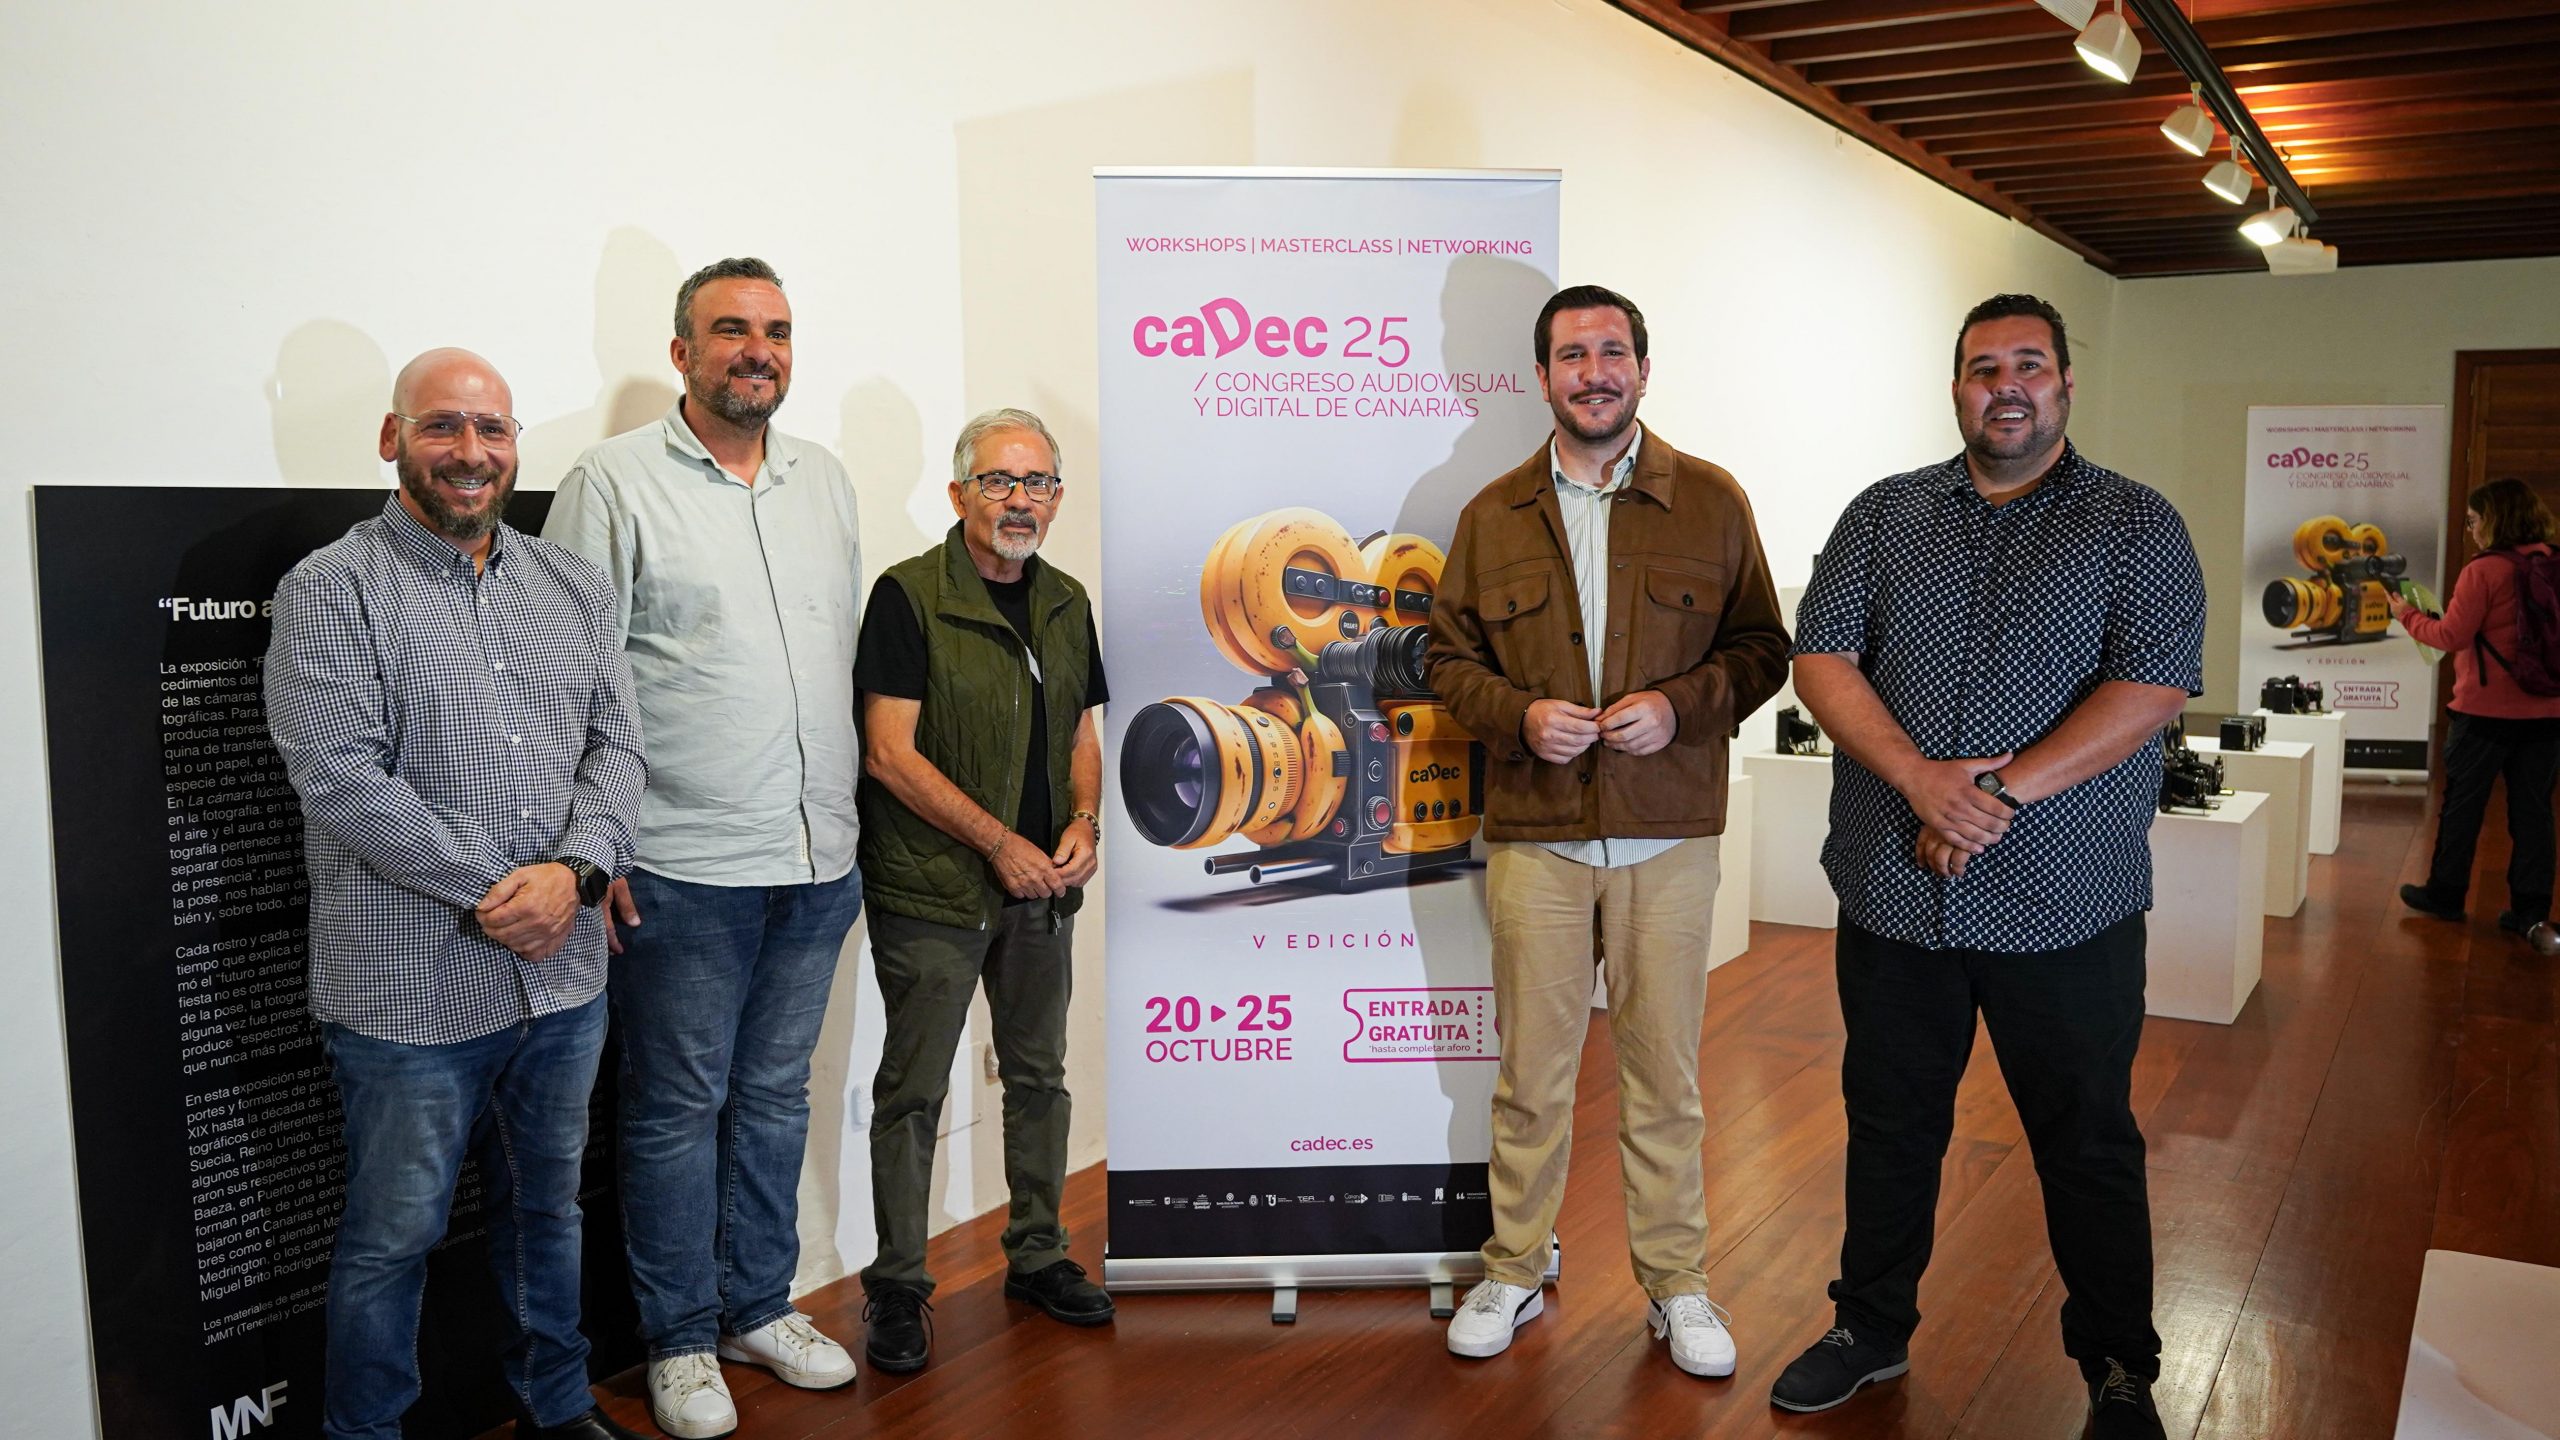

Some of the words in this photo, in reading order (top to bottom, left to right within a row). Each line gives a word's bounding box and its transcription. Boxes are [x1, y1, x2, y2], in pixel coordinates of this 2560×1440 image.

[1127, 237, 1246, 253] WORKSHOPS
[1261, 238, 1393, 254] MASTERCLASS
[1407, 239, 1533, 255] NETWORKING
[1133, 298, 1328, 359] caDec
[1343, 316, 1411, 368] 25
[1215, 372, 1355, 393] CONGRESO
[1361, 372, 1526, 394] AUDIOVISUAL
[1194, 397, 1209, 416] Y
[1216, 396, 1310, 418] DIGITAL
[1316, 397, 1349, 417] DE
[1354, 397, 1480, 418] CANARIAS
[2267, 447, 2339, 468] caDec
[2343, 453, 2369, 471] 25
[2296, 472, 2348, 480] CONGRESO
[2350, 472, 2410, 480] AUDIOVISUAL
[2296, 480, 2330, 488] DIGITAL
[2332, 480, 2344, 488] DE
[2347, 480, 2394, 488] CANARIAS
[160, 662, 177, 674] La
[180, 658, 247, 674] exposición
[161, 676, 237, 691] cedimientos
[240, 673, 258, 685] del
[162, 696, 179, 708] de
[182, 695, 201, 706] las
[204, 692, 257, 705] cámaras
[2343, 694, 2381, 702] GRATUITA
[231, 707, 259, 719] Para
[164, 726, 220, 744] producía
[164, 745, 200, 761] quina
[203, 743, 220, 755] de
[165, 763, 181, 776] tal
[196, 762, 212, 772] un
[1410, 763, 1460, 783] caDec
[166, 776, 216, 793] especie
[220, 774, 236, 786] de
[239, 771, 265, 784] vida
[167, 797, 184, 809] En
[188, 795, 204, 807] La
[207, 790, 253, 804] cámara
[168, 815, 184, 826] en
[188, 812, 199, 823] la
[169, 830, 180, 843] el
[184, 828, 208, 840] aire
[238, 821, 265, 833] aura
[170, 843, 217, 860] tografía
[221, 835, 281, 855] pertenece
[171, 860, 219, 876] separar
[221, 857, 244, 868] dos
[246, 850, 292, 865] láminas
[172, 880, 189, 893] de
[173, 897, 184, 909] la
[225, 889, 248, 900] nos
[250, 882, 290, 896] hablan
[174, 912, 201, 926] bién
[219, 904, 253, 918] sobre
[175, 944, 210, 959] Cada
[213, 938, 247, 952] rostro
[260, 929, 290, 943] cada
[1253, 935, 1265, 949] V
[1286, 930, 1416, 949] EDICIÓN
[176, 959, 219, 975] tiempo
[222, 954, 246, 968] que
[248, 946, 291, 962] explica
[178, 978, 198, 992] mó
[201, 975, 212, 988] el
[178, 994, 212, 1008] fiesta
[214, 990, 230, 1001] no
[232, 987, 247, 998] es
[249, 982, 272, 994] otra
[274, 975, 303, 989] cosa
[180, 1013, 197, 1025] de
[200, 1010, 211, 1021] la
[1145, 996, 1200, 1033] 20
[1237, 994, 1292, 1031] 25
[1368, 1000, 1470, 1017] ENTRADA
[181, 1024, 223, 1042] alguna
[225, 1019, 246, 1031] vez
[249, 1015, 267, 1026] fue
[1368, 1024, 1470, 1041] GRATUITA
[182, 1039, 233, 1060] produce
[1146, 1038, 1293, 1063] OCTUBRE
[1398, 1044, 1445, 1054] completar
[1447, 1043, 1471, 1052] aforo
[183, 1061, 207, 1076] que
[210, 1052, 248, 1068] nunca
[251, 1044, 276, 1058] más
[185, 1094, 202, 1107] En
[204, 1088, 230, 1102] esta
[232, 1072, 295, 1095] exposición
[187, 1106, 225, 1126] portes
[238, 1090, 289, 1110] formatos
[187, 1123, 209, 1139] XIX
[211, 1117, 245, 1133] hasta
[248, 1113, 258, 1123] la
[261, 1101, 305, 1120] década
[189, 1132, 249, 1156] tográficos
[251, 1128, 266, 1139] de
[239, 1142, 273, 1159] Reino
[1290, 1136, 1374, 1153] cadec.es
[192, 1167, 239, 1189] algunos
[242, 1153, 289, 1174] trabajos
[291, 1148, 306, 1160] de
[193, 1188, 225, 1205] raron
[227, 1181, 248, 1195] sus
[250, 1161, 317, 1188] respectivos
[239, 1196, 254, 1207] en
[257, 1184, 295, 1202] Puerto
[195, 1217, 237, 1237] forman
[241, 1207, 271, 1226] parte
[275, 1200, 290, 1212] de
[294, 1193, 315, 1207] una
[197, 1232, 242, 1253] bajaron
[245, 1226, 260, 1238] en
[263, 1210, 314, 1232] Canarias
[198, 1253, 226, 1269] bres
[229, 1242, 262, 1260] como
[265, 1235, 275, 1248] el
[201, 1278, 241, 1302] Miguel
[244, 1272, 271, 1287] Brito
[203, 1318, 222, 1331] Los
[224, 1301, 273, 1324] materiales
